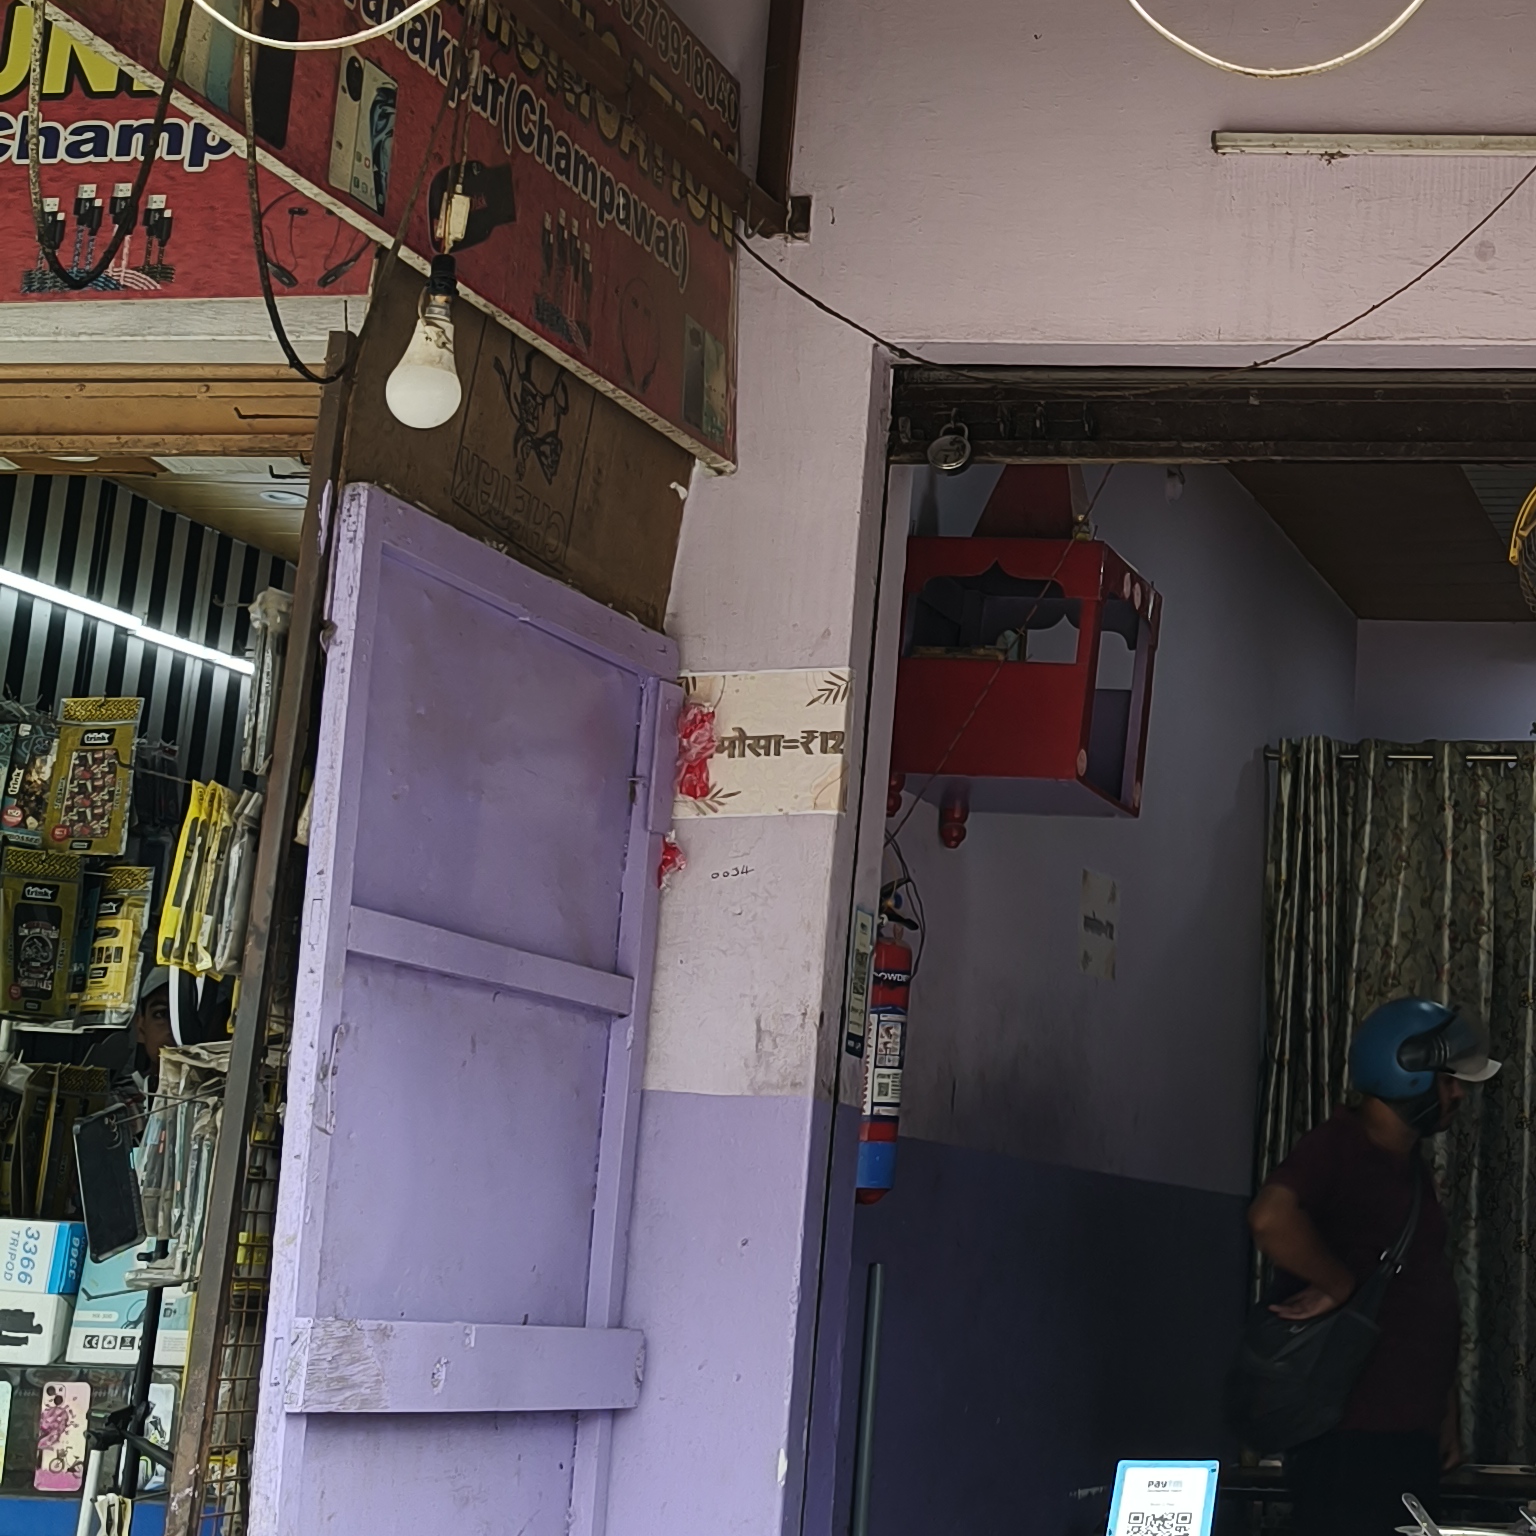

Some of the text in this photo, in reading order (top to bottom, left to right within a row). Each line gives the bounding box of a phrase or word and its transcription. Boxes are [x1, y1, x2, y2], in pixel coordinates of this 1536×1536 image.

[709, 726, 845, 759] मोसा=₹12
[3, 1230, 21, 1281] TRIPOD
[17, 1226, 41, 1285] 3366
